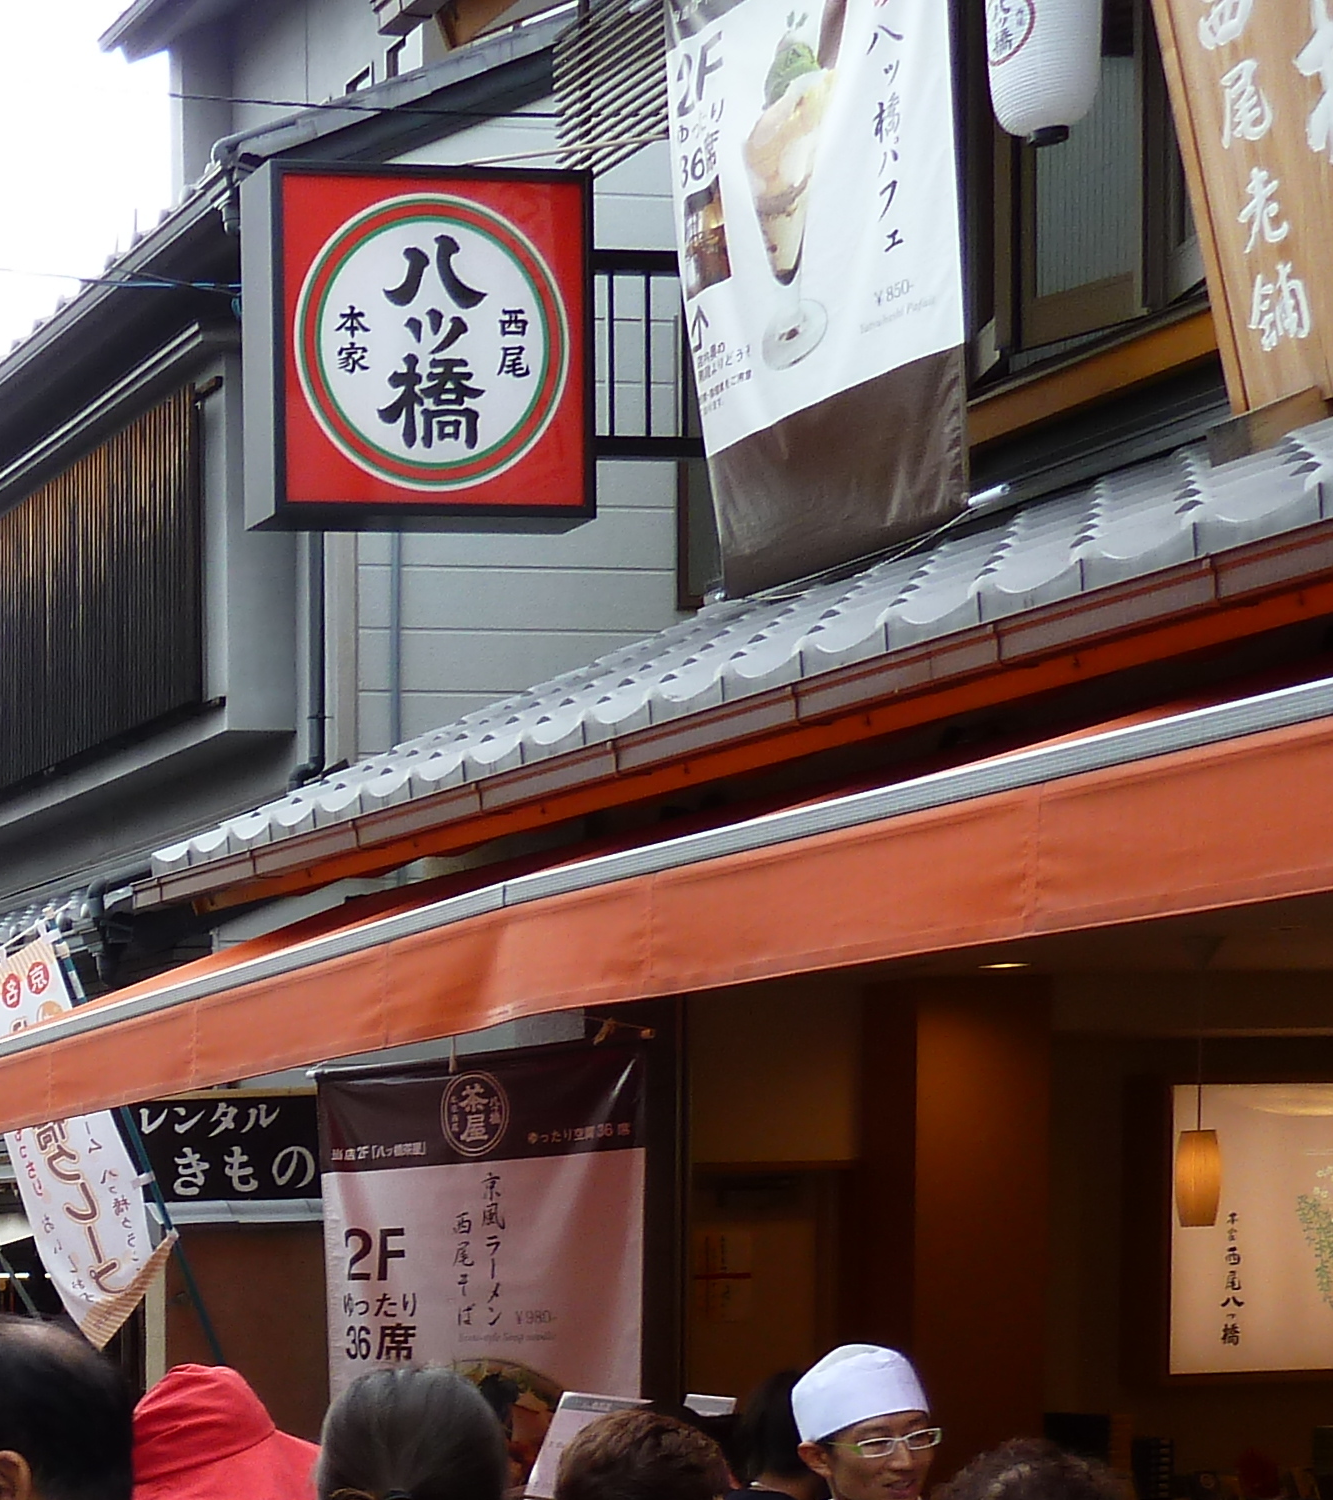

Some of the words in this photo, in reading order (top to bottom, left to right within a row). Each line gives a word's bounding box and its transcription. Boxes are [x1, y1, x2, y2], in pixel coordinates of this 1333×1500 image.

[676, 30, 724, 117] 2F
[334, 304, 371, 374] 本家
[496, 308, 531, 379] 西尾
[138, 1101, 281, 1138] レンタル
[458, 1082, 489, 1143] 茶屋
[172, 1145, 316, 1196] きもの
[343, 1227, 406, 1282] 2F
[452, 1211, 475, 1327] 西尾そば
[480, 1172, 506, 1327] 京風ラーメン
[343, 1292, 417, 1319] ゆったり
[345, 1322, 417, 1361] 36席
